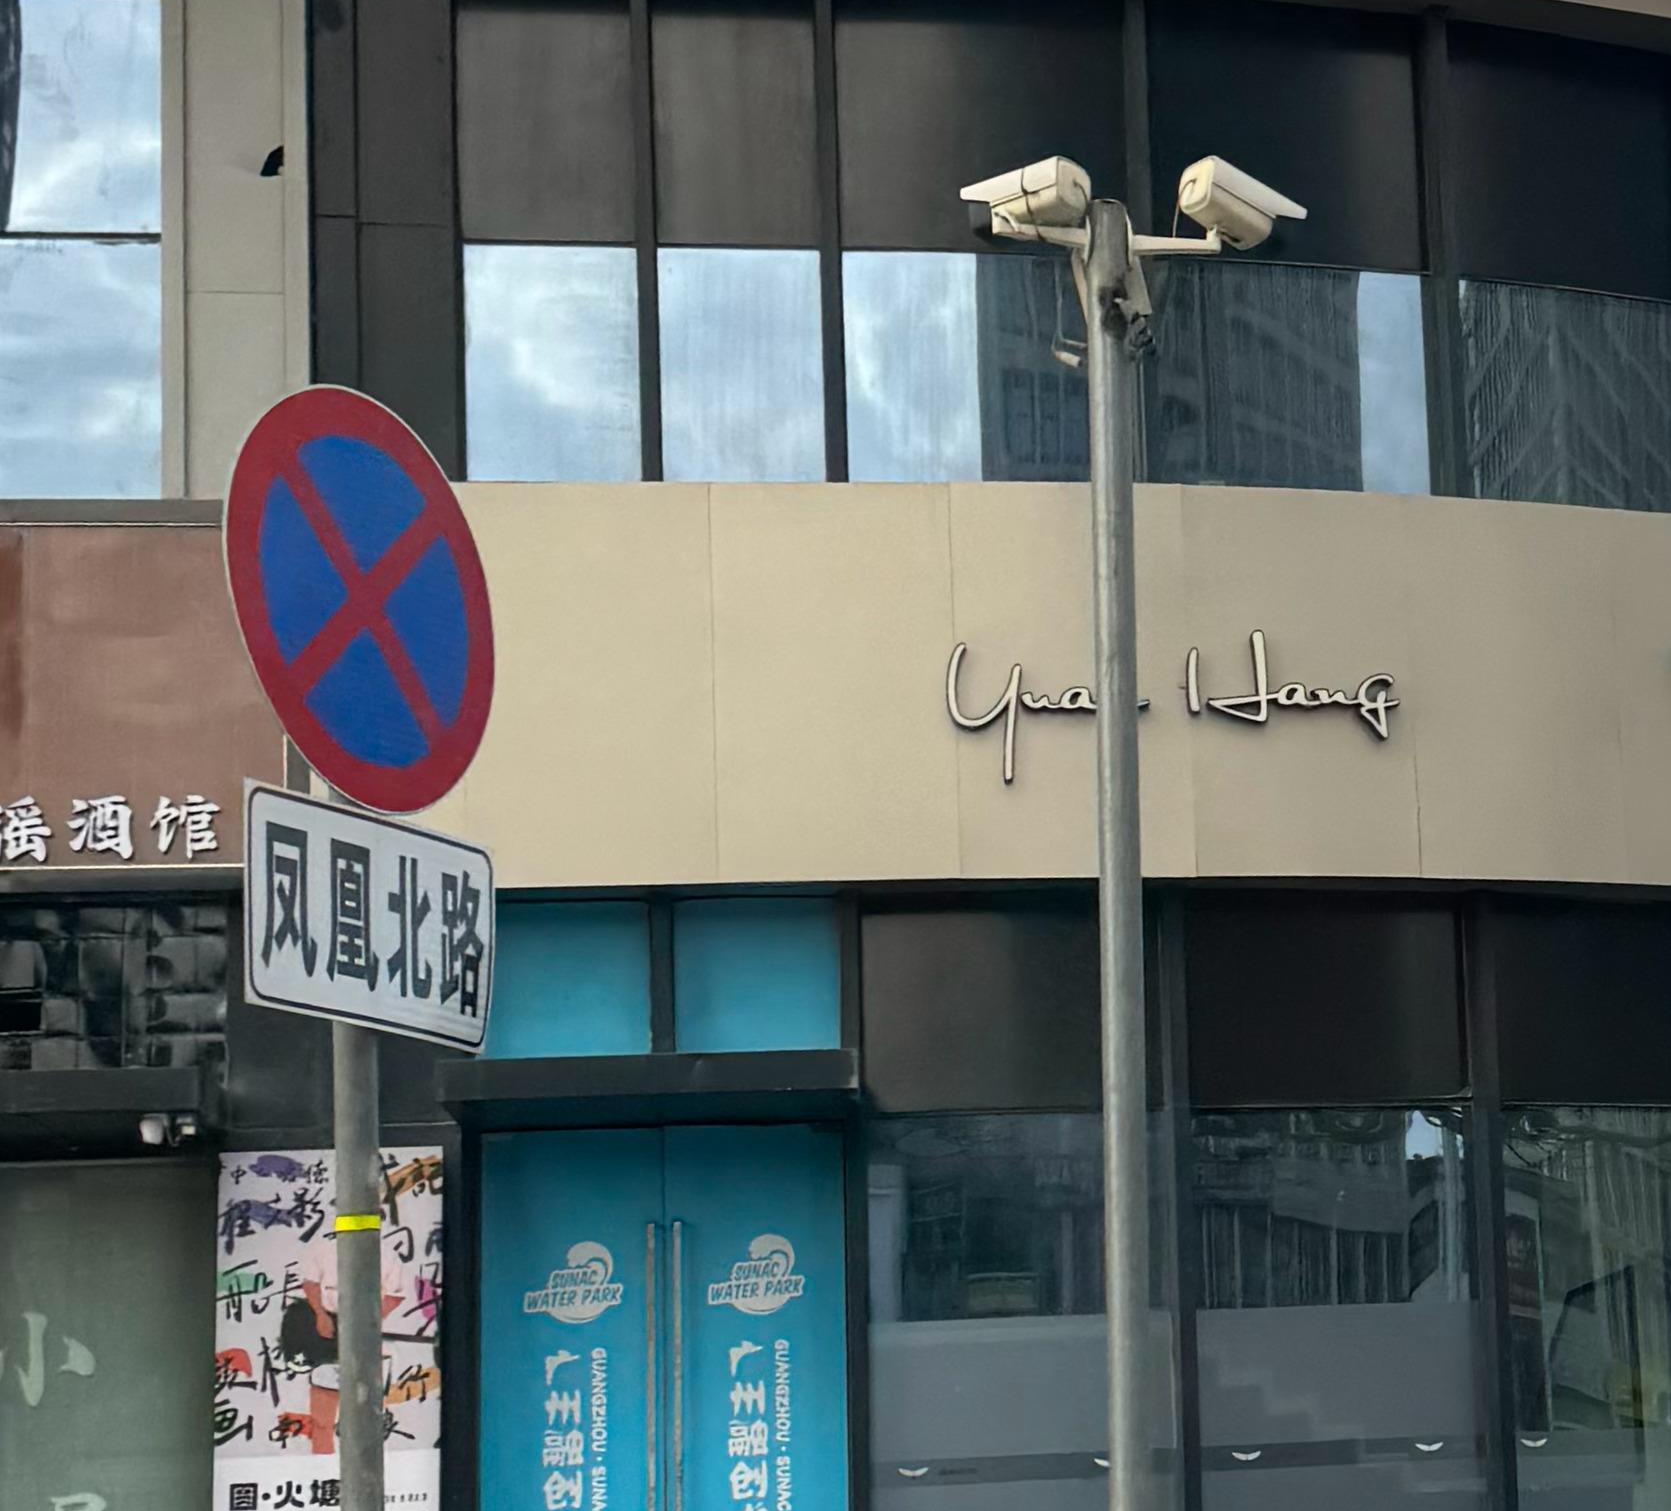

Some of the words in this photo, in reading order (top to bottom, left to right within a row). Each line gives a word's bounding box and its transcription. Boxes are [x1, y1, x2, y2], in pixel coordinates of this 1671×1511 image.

[945, 642, 1150, 785] Yua
[1186, 629, 1400, 742] Hang
[261, 820, 485, 1018] 凤凰北路
[527, 1289, 578, 1310] WATER
[580, 1285, 622, 1306] PARK
[551, 1269, 598, 1289] SUNAC
[711, 1282, 760, 1302] WATER
[763, 1276, 805, 1297] PARK
[735, 1262, 781, 1281] SUNAC
[590, 1347, 608, 1452] GUANGZHOU
[774, 1339, 791, 1443] GUANGZHOU
[775, 1455, 792, 1511] SUNAC
